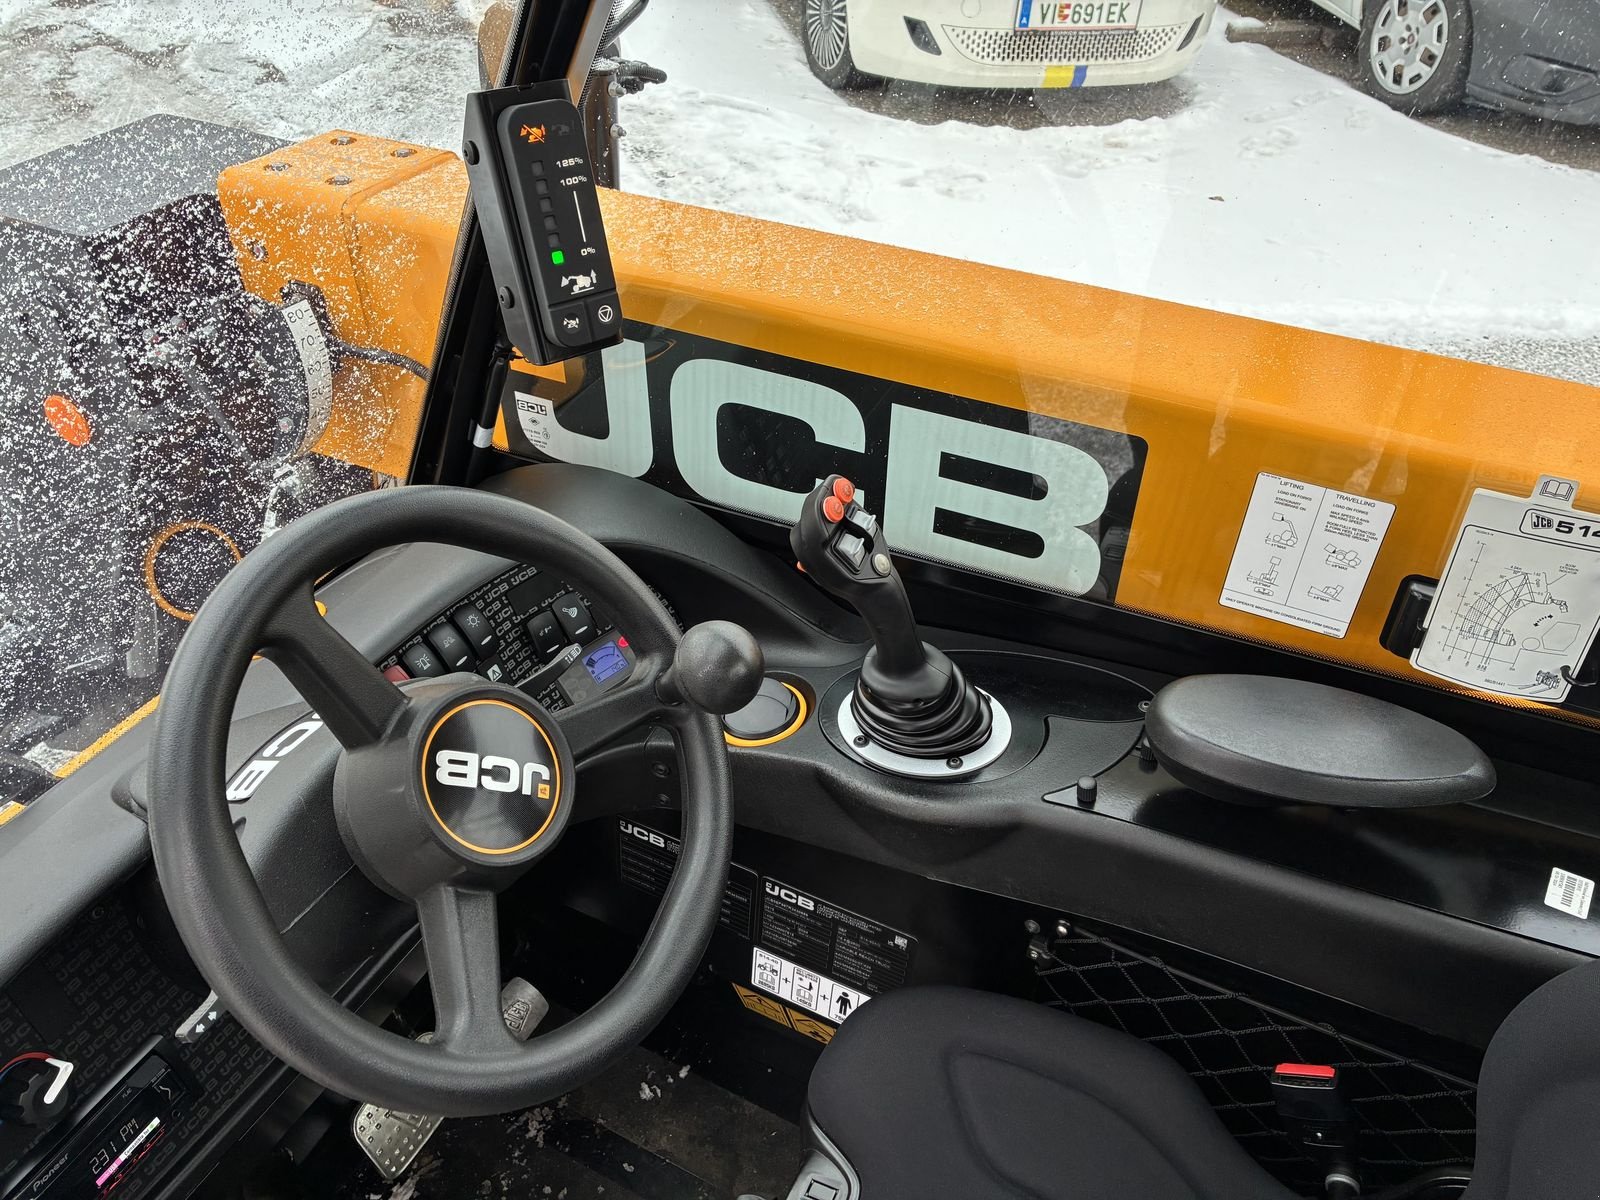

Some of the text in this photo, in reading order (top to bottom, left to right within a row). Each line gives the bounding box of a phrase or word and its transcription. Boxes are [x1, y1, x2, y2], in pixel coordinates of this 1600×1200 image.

[1040, 2, 1128, 24] VI 691EK
[556, 157, 583, 168] 125%
[560, 175, 588, 187] 100%
[580, 247, 596, 256] 0%
[509, 338, 1110, 598] JCB
[1279, 480, 1304, 490] LIFTING
[1335, 494, 1376, 507] TRAVELLING
[1533, 514, 1552, 529] JCB
[511, 566, 538, 586] JCB
[484, 582, 510, 602] JCB
[500, 640, 522, 660] JCB
[511, 660, 532, 680] JCB
[226, 711, 324, 802] CB
[435, 750, 550, 798] JCB
[620, 822, 665, 849] JCB
[766, 882, 815, 912] JCB
[32, 1152, 70, 1192] Pioneer
